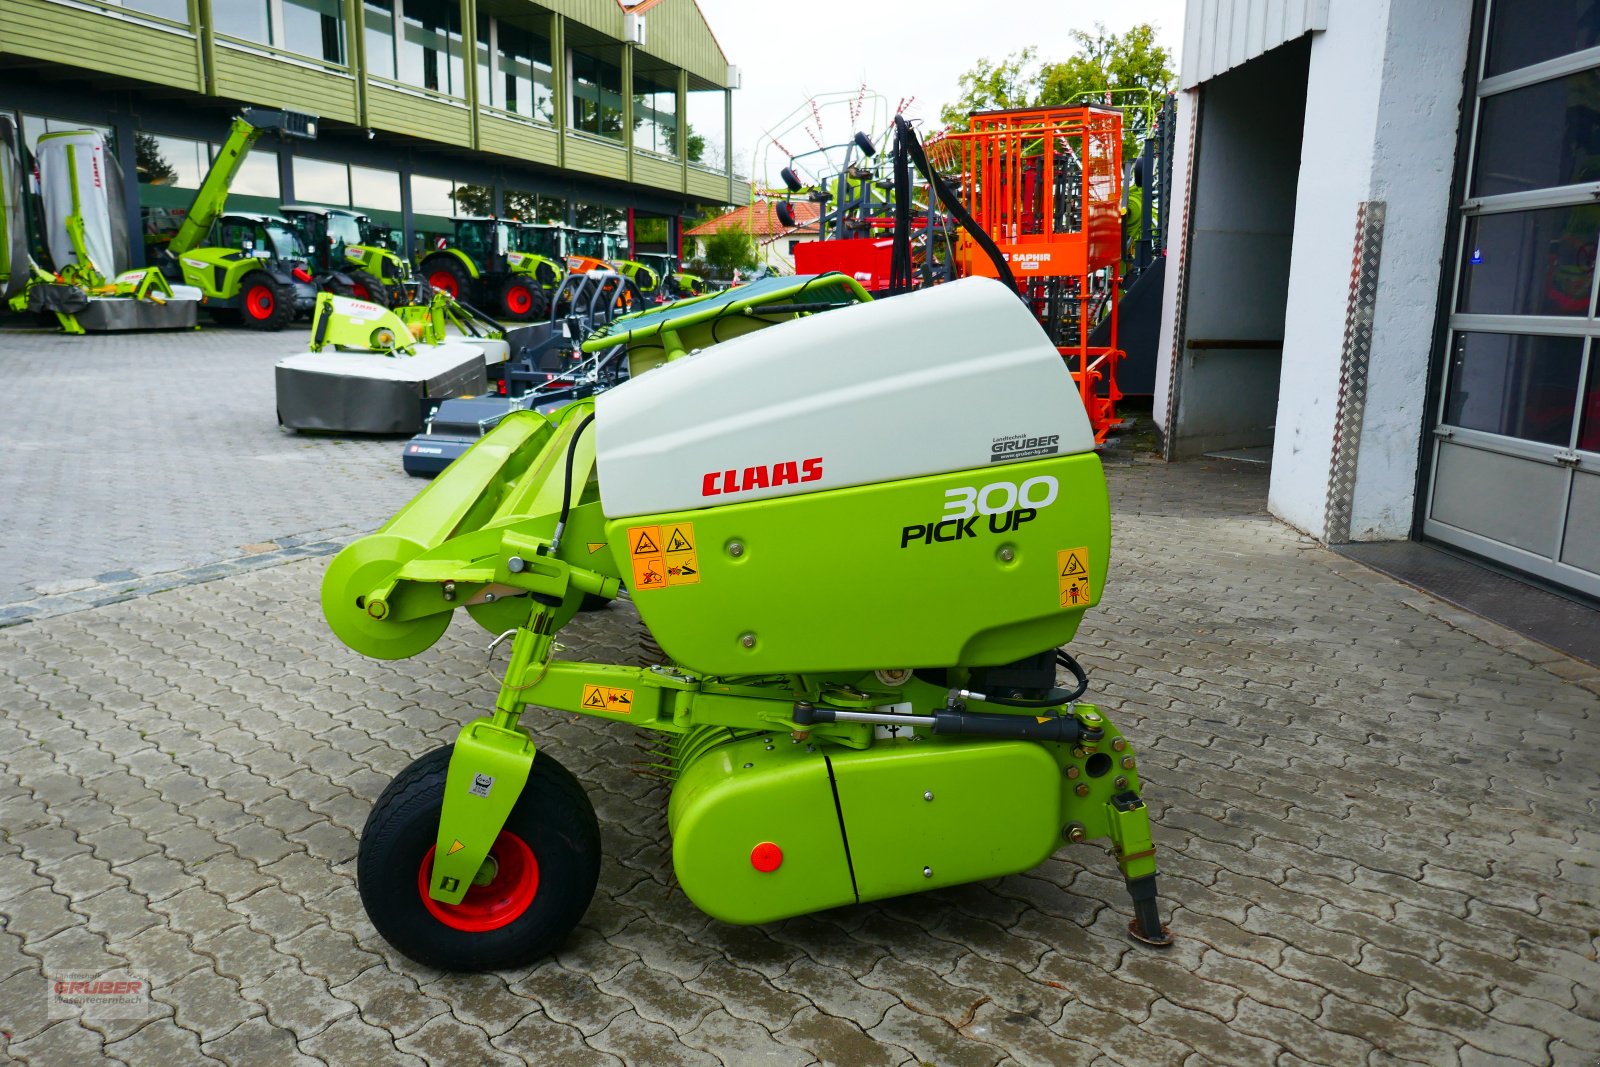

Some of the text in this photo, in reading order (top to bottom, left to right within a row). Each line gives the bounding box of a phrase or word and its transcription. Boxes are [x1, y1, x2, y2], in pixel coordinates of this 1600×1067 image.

[1012, 252, 1052, 263] SAPHIR
[991, 434, 1060, 453] GRUBER
[992, 433, 1027, 443] Landtechnik
[702, 457, 823, 497] CLAAS
[942, 475, 1059, 522] 300
[900, 507, 1038, 549] PICK UP
